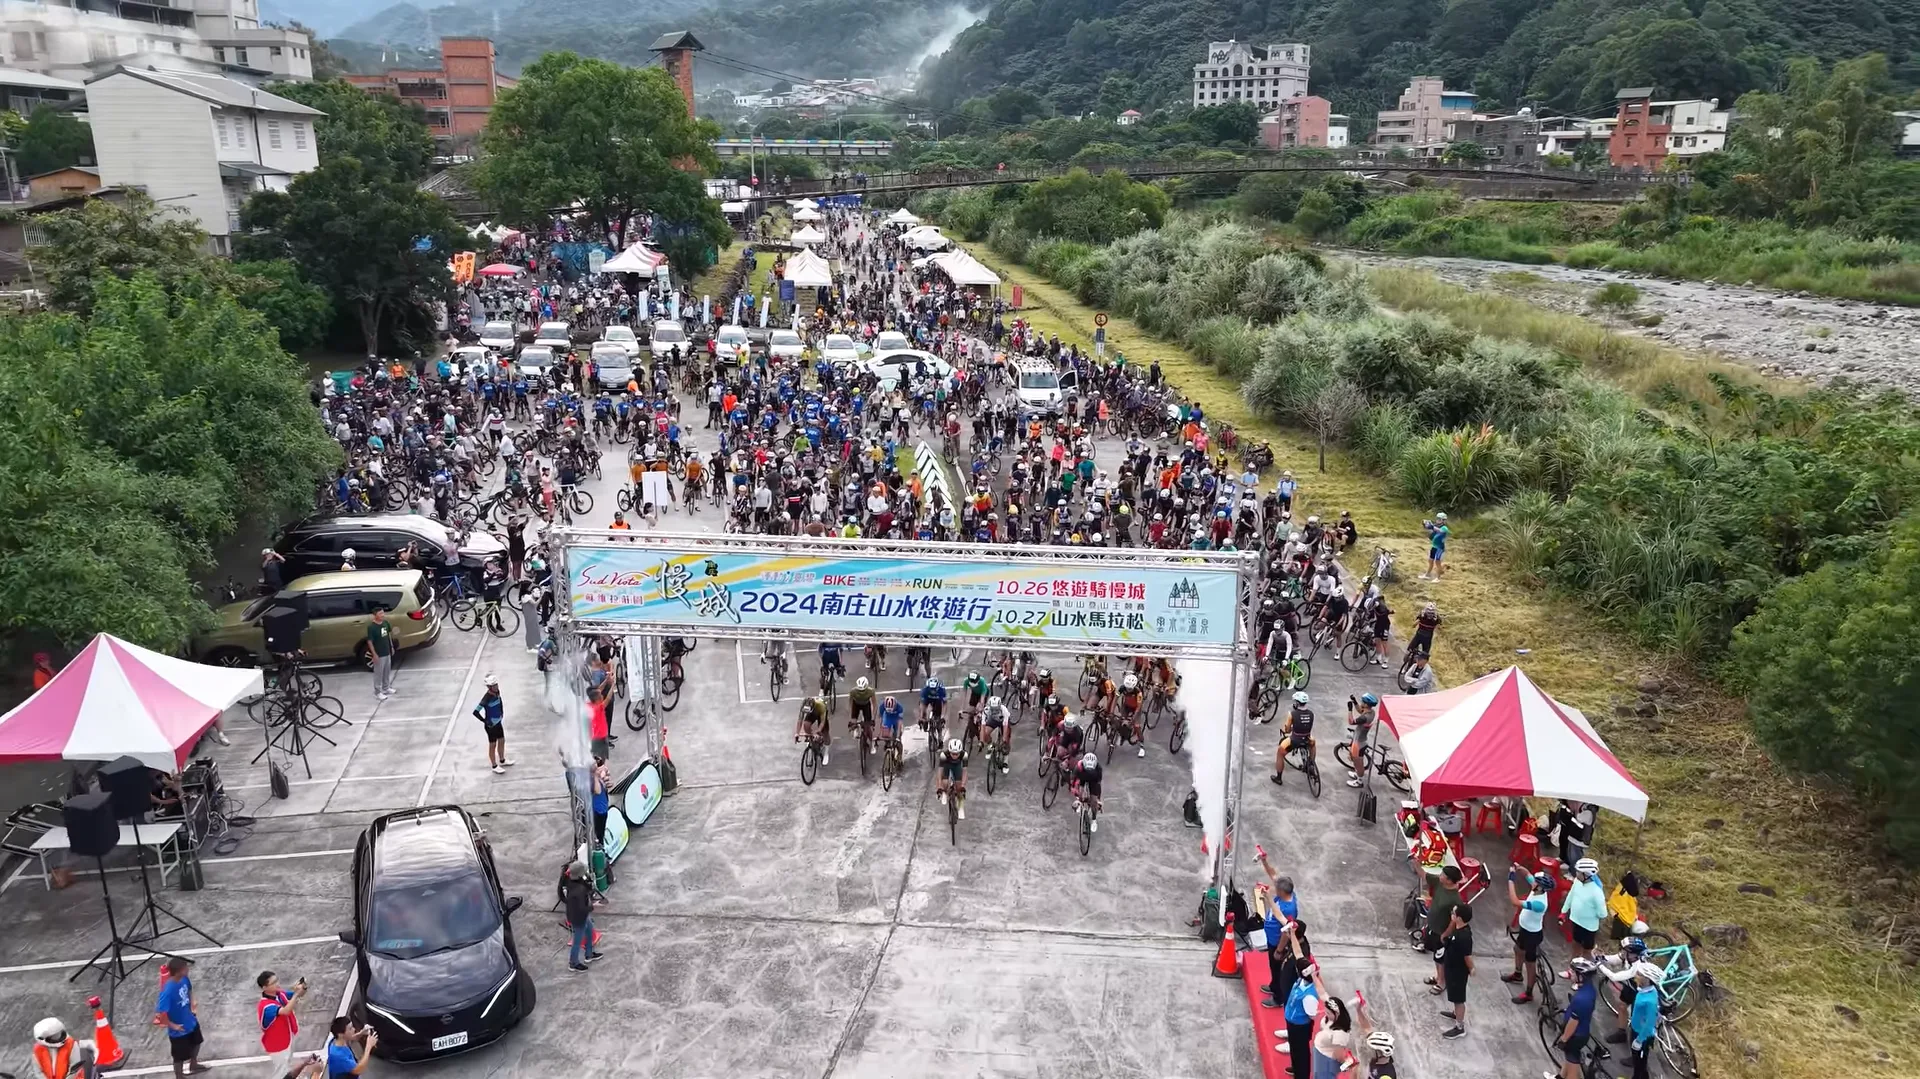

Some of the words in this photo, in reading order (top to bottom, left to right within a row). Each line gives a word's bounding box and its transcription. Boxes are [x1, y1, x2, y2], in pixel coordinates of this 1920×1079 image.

[654, 558, 742, 623] 慢城
[823, 574, 856, 587] BIKE
[912, 578, 943, 589] RUN
[996, 580, 1049, 596] 10.26
[1052, 579, 1146, 600] 悠遊騎慢城
[740, 590, 993, 622] 2024南庄山水悠遊行
[994, 609, 1047, 625] 10.27
[1052, 610, 1145, 631] 山水馬拉松
